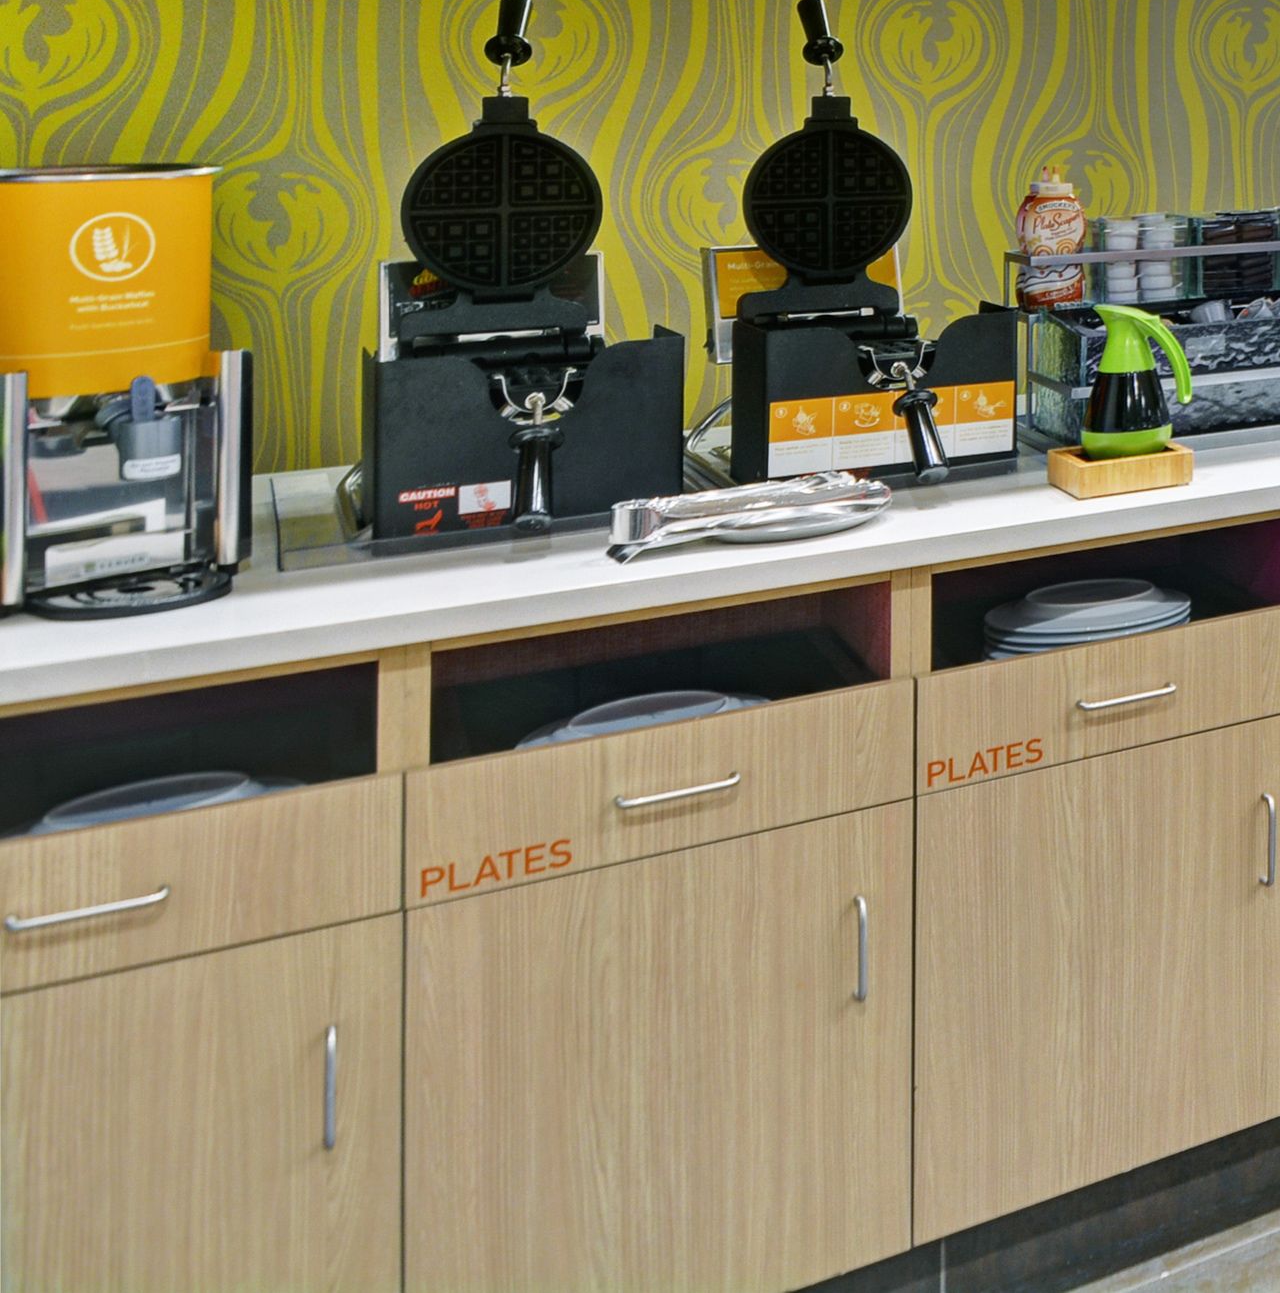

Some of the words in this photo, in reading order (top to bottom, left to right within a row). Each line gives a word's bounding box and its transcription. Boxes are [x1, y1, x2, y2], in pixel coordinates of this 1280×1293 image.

[400, 487, 455, 503] CAUTION
[414, 499, 439, 511] HOT
[926, 737, 1044, 787] PLATES
[419, 838, 573, 898] PLATES
